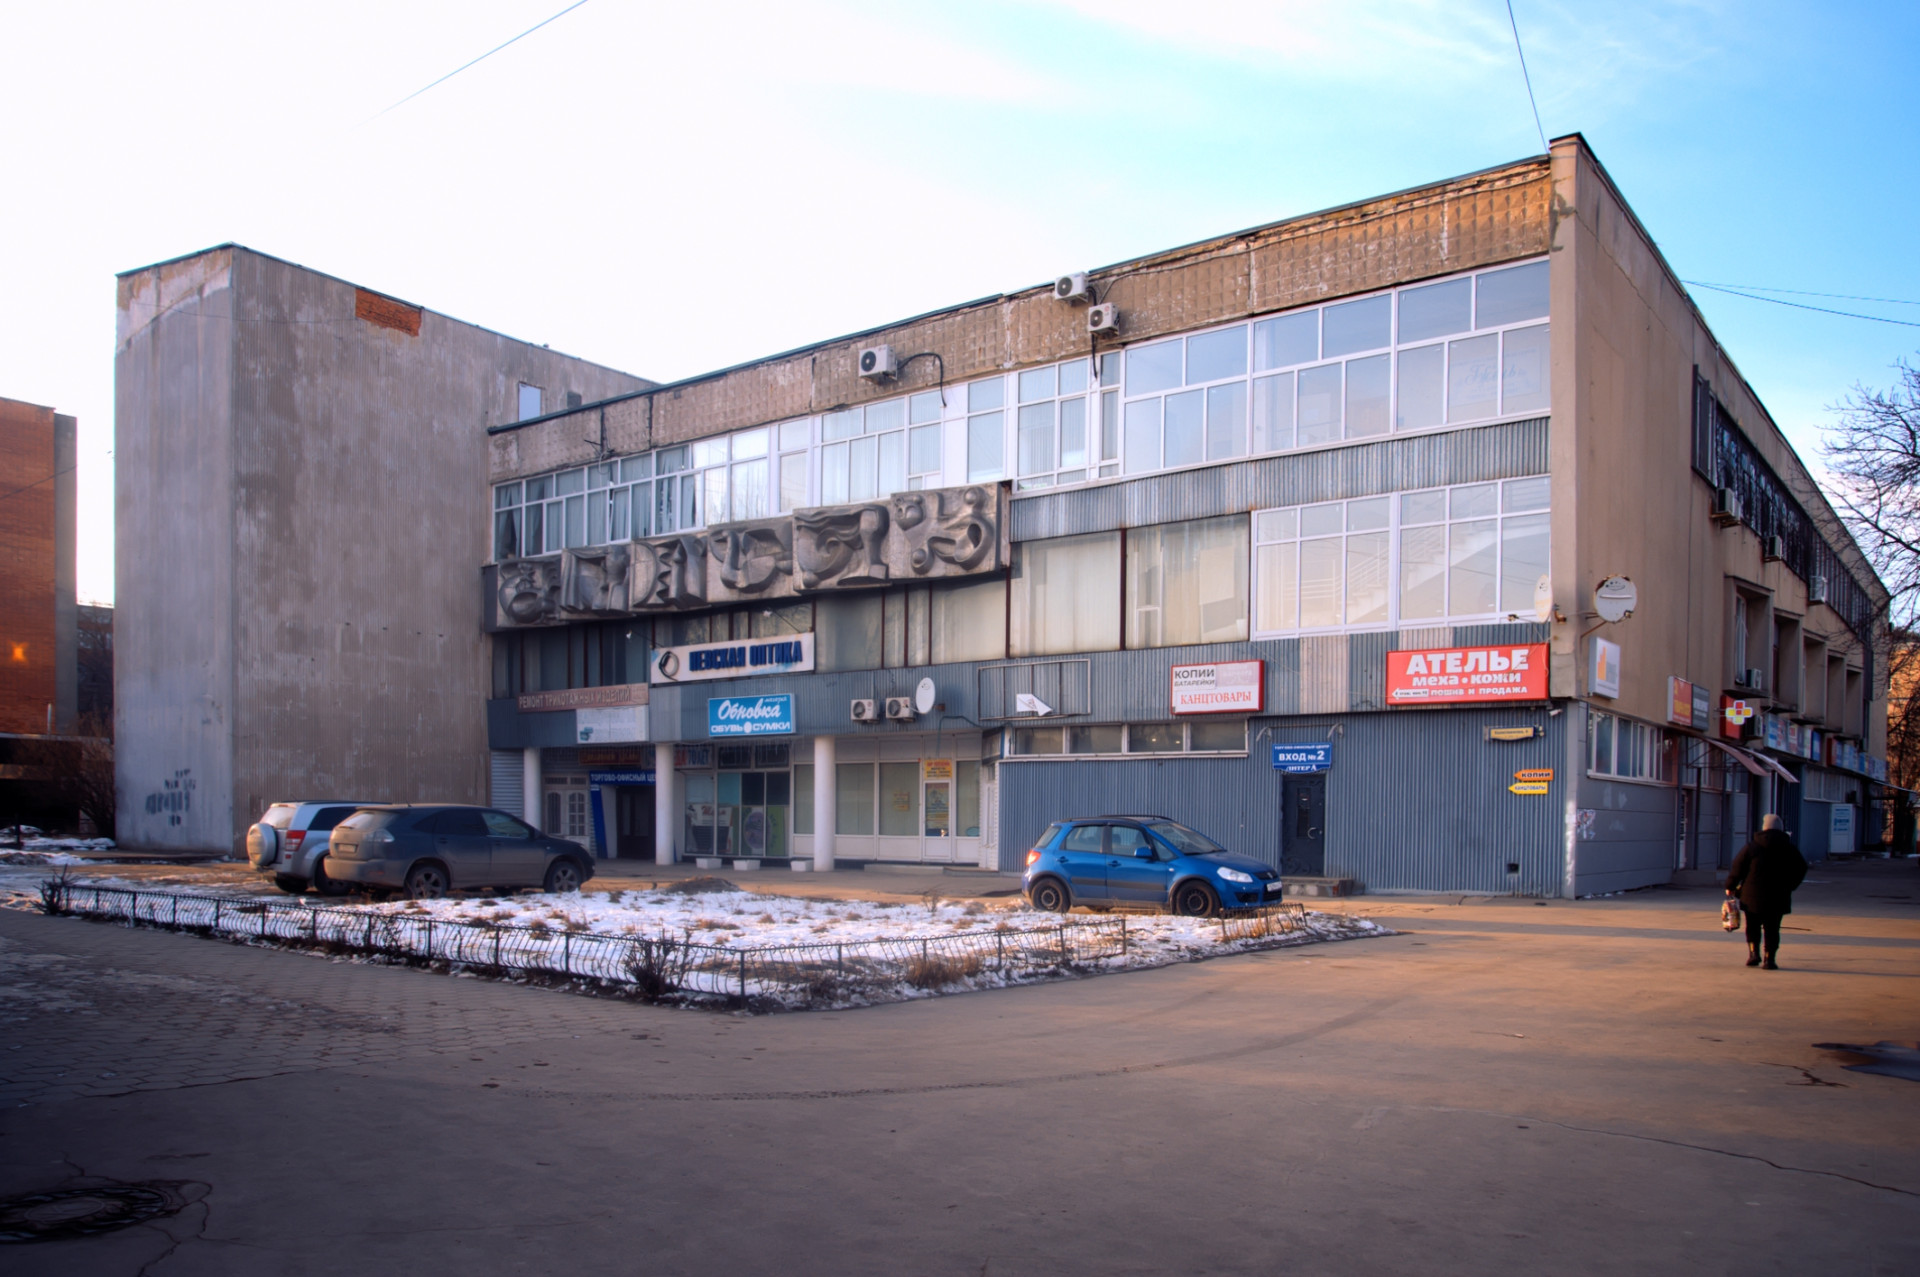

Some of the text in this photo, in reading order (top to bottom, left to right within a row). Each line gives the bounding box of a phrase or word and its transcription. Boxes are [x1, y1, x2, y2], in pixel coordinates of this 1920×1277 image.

[689, 641, 803, 671] НЕВСКАЯ ОПТИКА
[1406, 648, 1529, 675] АТЕЛЬЕ
[1174, 669, 1215, 680] КОПИИ
[1174, 679, 1215, 687] БАТАРЕЙКИ
[1431, 688, 1464, 696] ПОШИВ
[1478, 686, 1528, 696] ПРОДАЖА
[518, 687, 631, 709] РЕМОНТ ТРИКОТАЖНЫХ ИЗДЕЛИЙ
[1180, 691, 1252, 705] КАНЦТОВАРЫ
[718, 699, 782, 720] Обновка
[711, 721, 790, 733] ОБУВЬ СУМКИ
[1278, 752, 1307, 762] ВХОД
[1317, 750, 1325, 760] 2
[590, 773, 646, 782] ТОРГОВО-ОФИСНЫЙ
